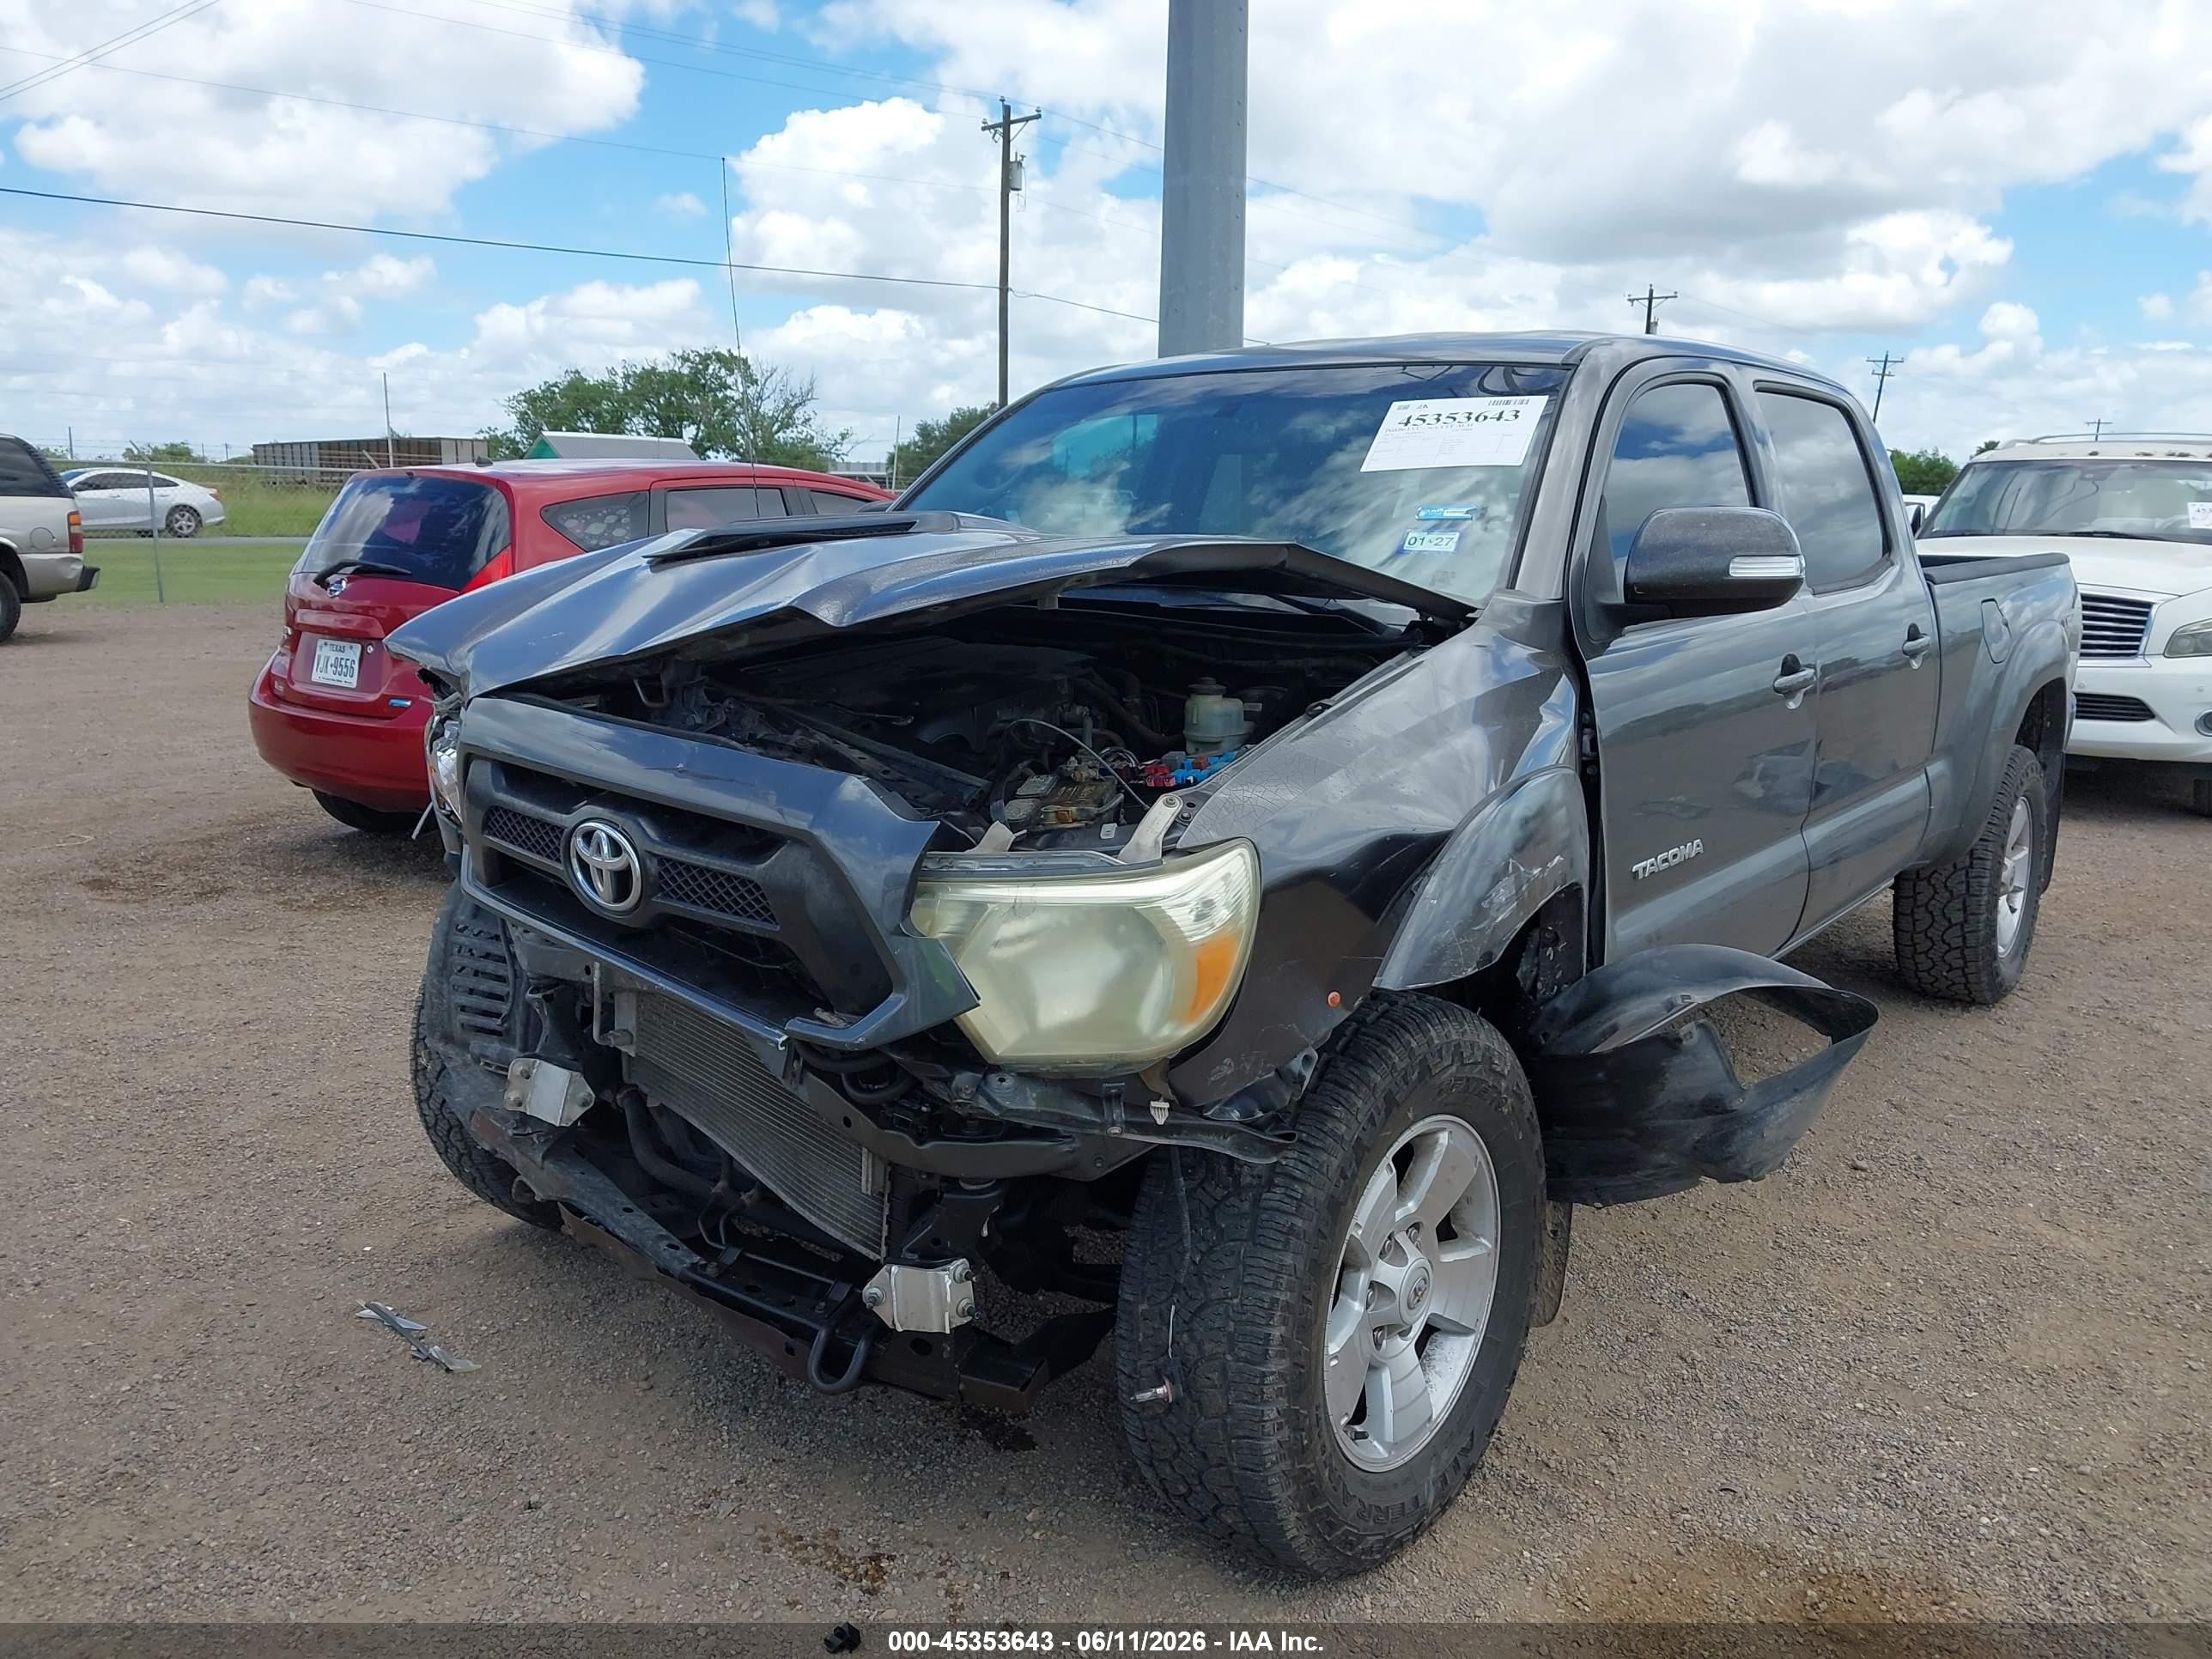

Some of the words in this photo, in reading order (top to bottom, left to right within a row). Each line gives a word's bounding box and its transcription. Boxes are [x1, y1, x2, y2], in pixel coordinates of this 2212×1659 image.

[1398, 409, 1520, 427] 45353643
[329, 643, 345, 653] TEXAS
[1632, 838, 1704, 880] TACOMA
